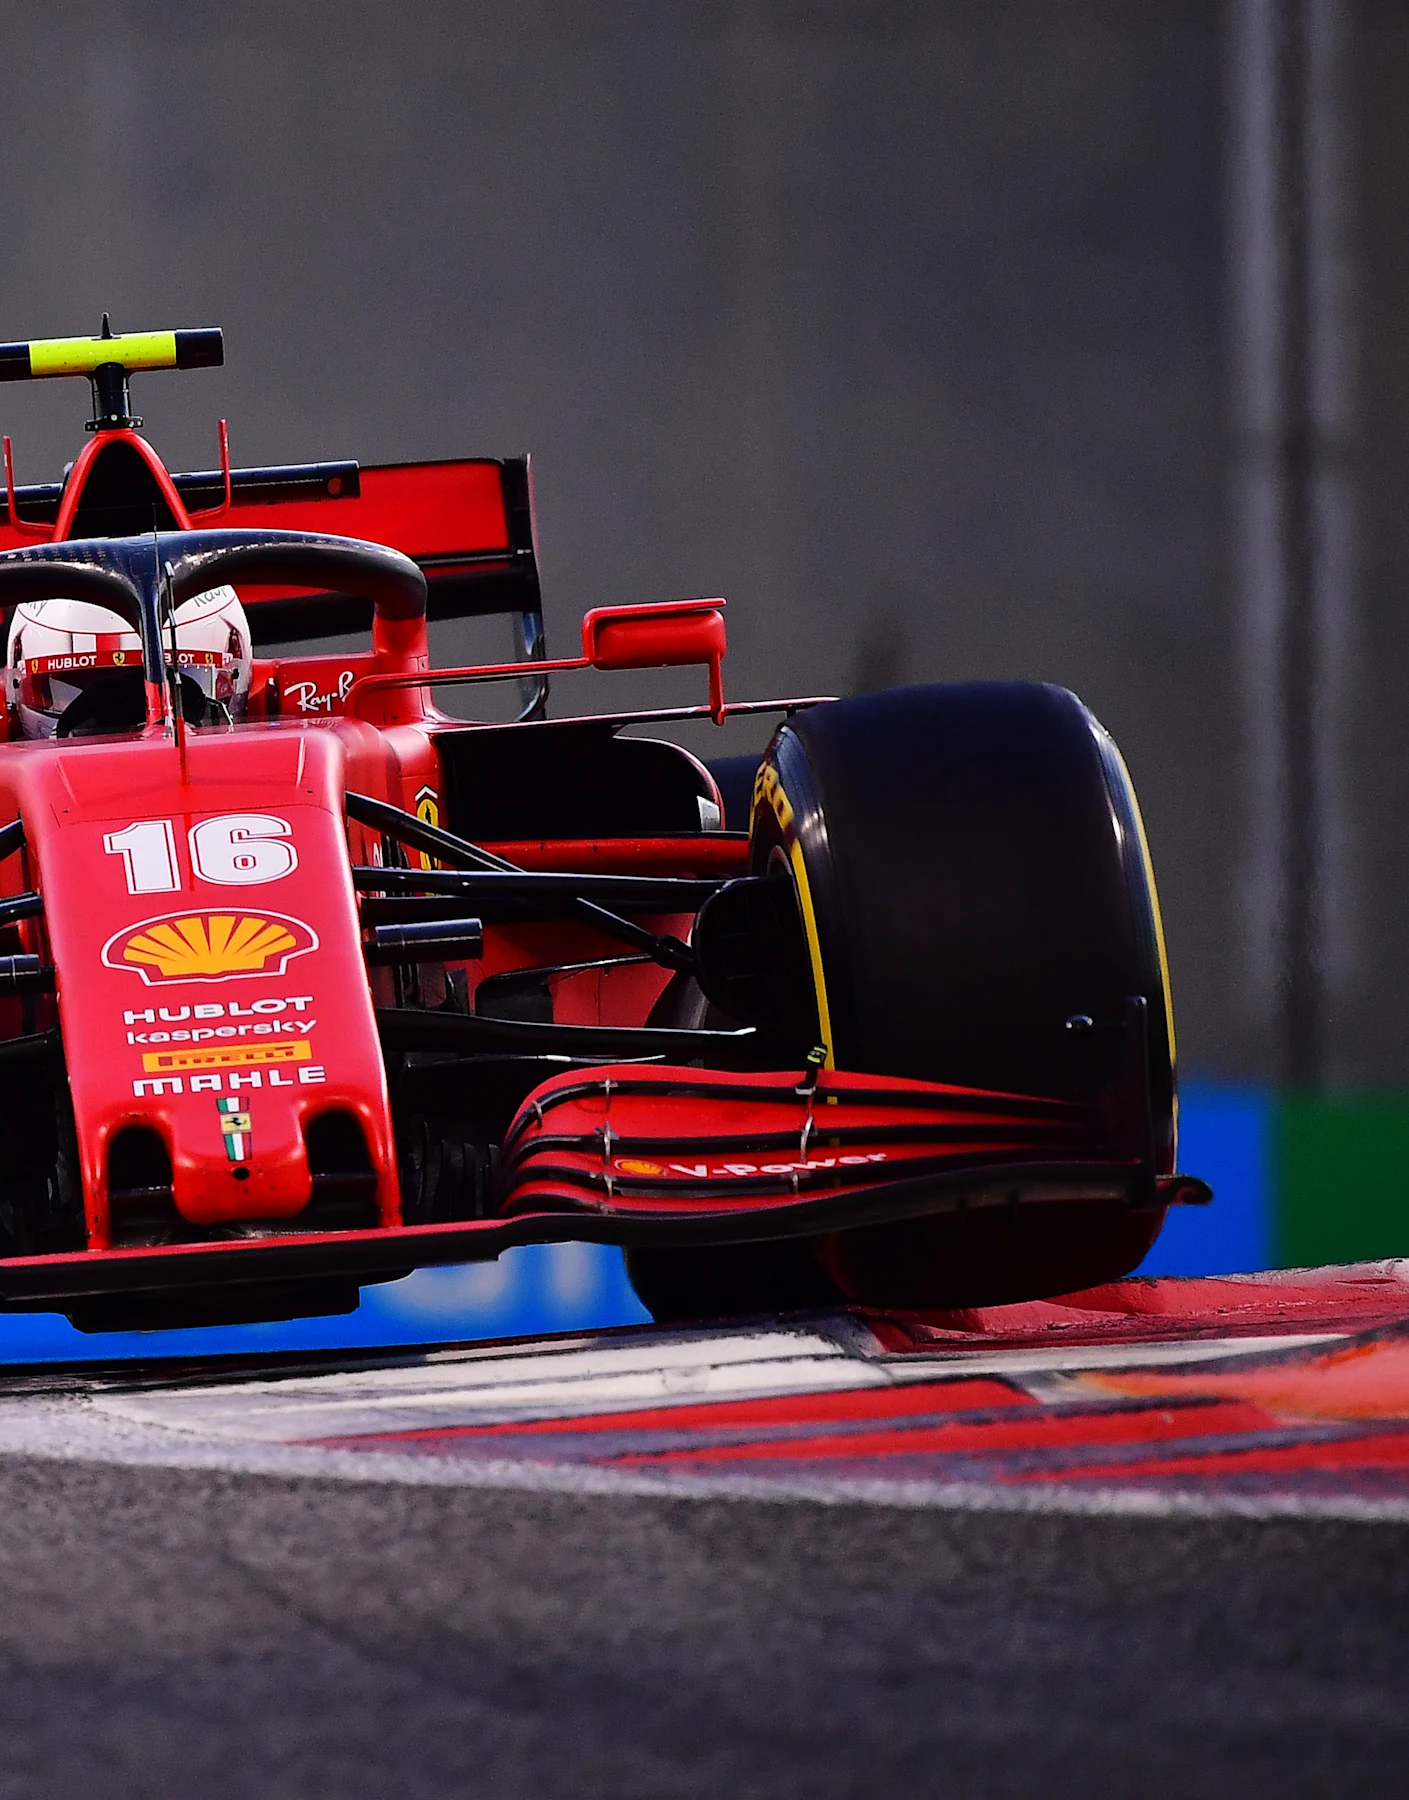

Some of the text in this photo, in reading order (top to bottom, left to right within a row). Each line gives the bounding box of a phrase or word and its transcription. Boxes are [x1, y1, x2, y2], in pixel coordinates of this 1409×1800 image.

[47, 655, 97, 670] HUBLOT
[284, 671, 354, 712] Ray-B
[103, 814, 299, 895] 16
[123, 996, 314, 1025] HUBLOT
[127, 1019, 317, 1045] kaspersky
[133, 1066, 327, 1097] MAHLE
[669, 1153, 888, 1178] V-Power
